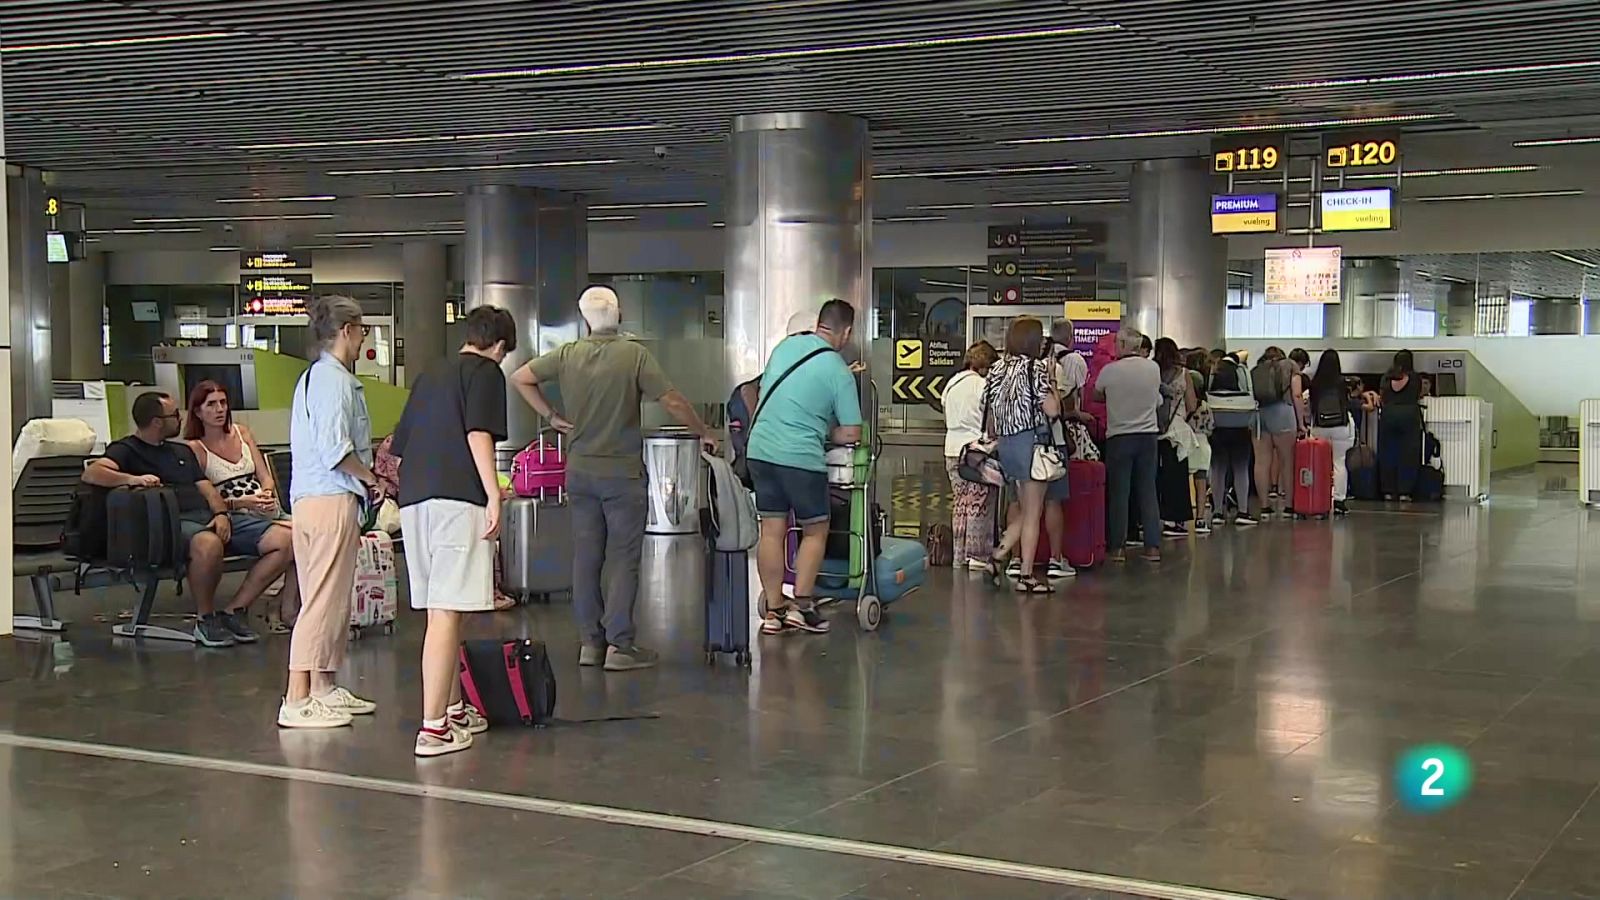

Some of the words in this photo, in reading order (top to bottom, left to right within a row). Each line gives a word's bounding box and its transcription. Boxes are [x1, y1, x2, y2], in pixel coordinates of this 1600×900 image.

[1350, 141, 1396, 166] 120
[1236, 147, 1278, 171] 119
[1215, 199, 1259, 211] PREMIUM
[1326, 196, 1372, 207] CHECK-IN
[1243, 216, 1271, 227] vueling
[1355, 213, 1384, 224] vueling
[1087, 306, 1111, 315] vueling
[1074, 328, 1111, 336] PREMIUM
[929, 341, 948, 350] Abflug
[929, 350, 961, 359] Departures
[929, 358, 954, 366] Salidas
[1438, 359, 1463, 369] 120
